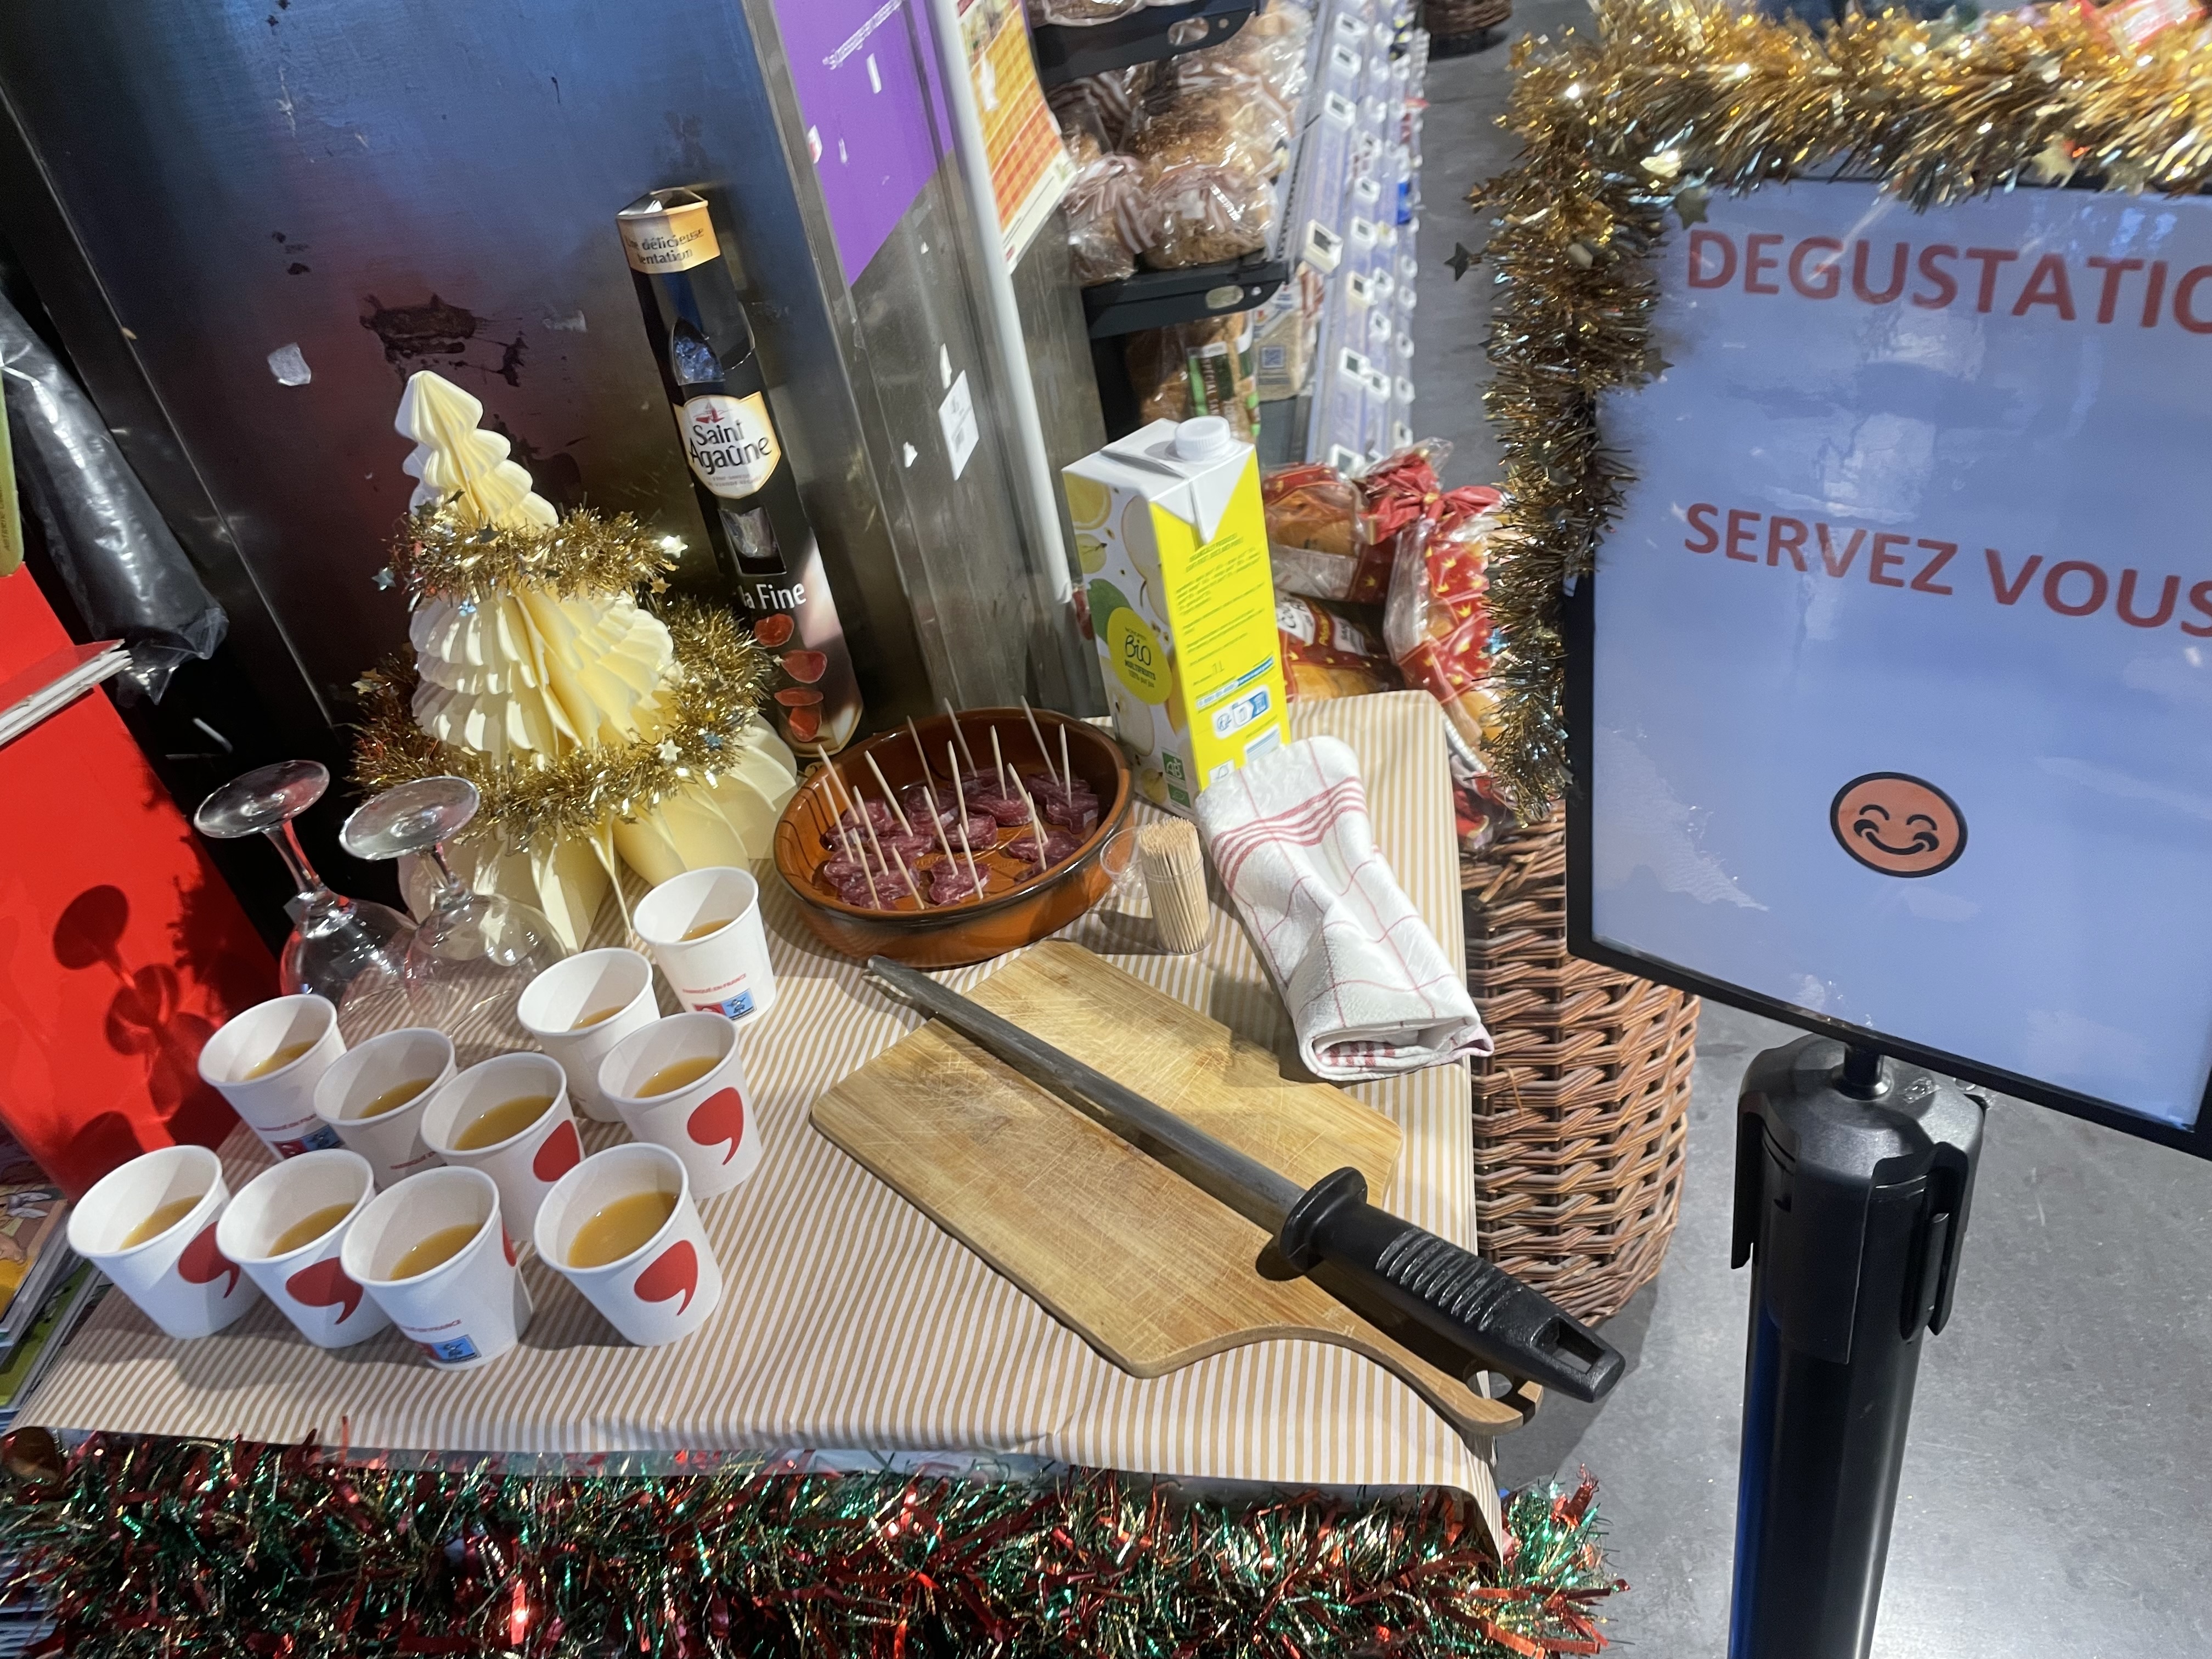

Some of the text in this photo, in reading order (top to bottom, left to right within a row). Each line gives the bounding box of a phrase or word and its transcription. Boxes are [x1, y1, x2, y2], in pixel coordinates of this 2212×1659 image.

[642, 228, 704, 251] délicieuse
[692, 419, 744, 446] Saint
[690, 437, 772, 475] Agaûne
[1684, 502, 1959, 596] SERVEZ
[756, 583, 806, 610] Fine
